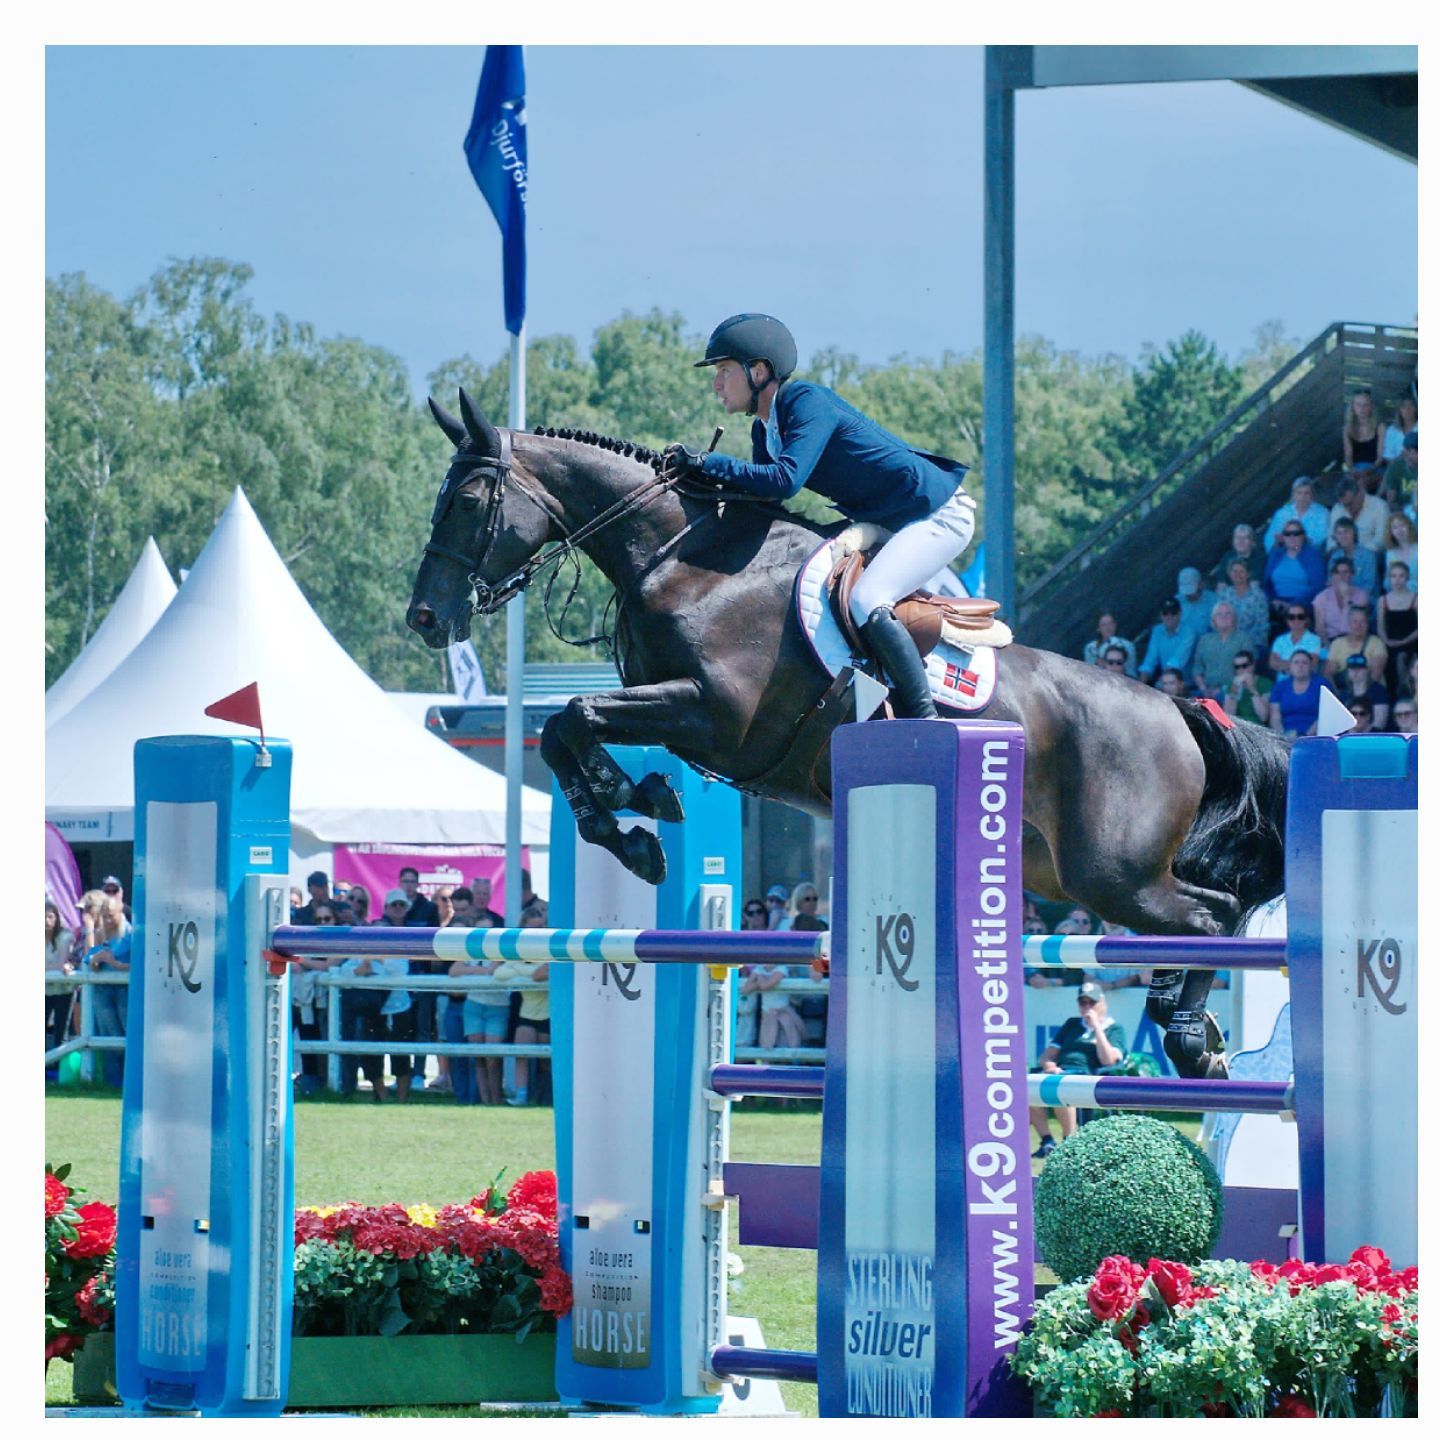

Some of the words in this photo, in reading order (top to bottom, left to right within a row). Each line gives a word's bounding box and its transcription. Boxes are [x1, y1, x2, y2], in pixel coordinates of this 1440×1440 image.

[168, 921, 202, 993] K9
[876, 913, 919, 992] K9
[1357, 937, 1407, 1016] K9
[969, 739, 1018, 1349] www.k9competition.com
[590, 1248, 608, 1267] aloe
[611, 1252, 633, 1268] vera
[848, 1253, 932, 1311] STERLING
[592, 1282, 632, 1304] shampoo
[142, 1308, 202, 1356] HORSE
[576, 1306, 646, 1354] HORSE
[849, 1311, 931, 1359] silver
